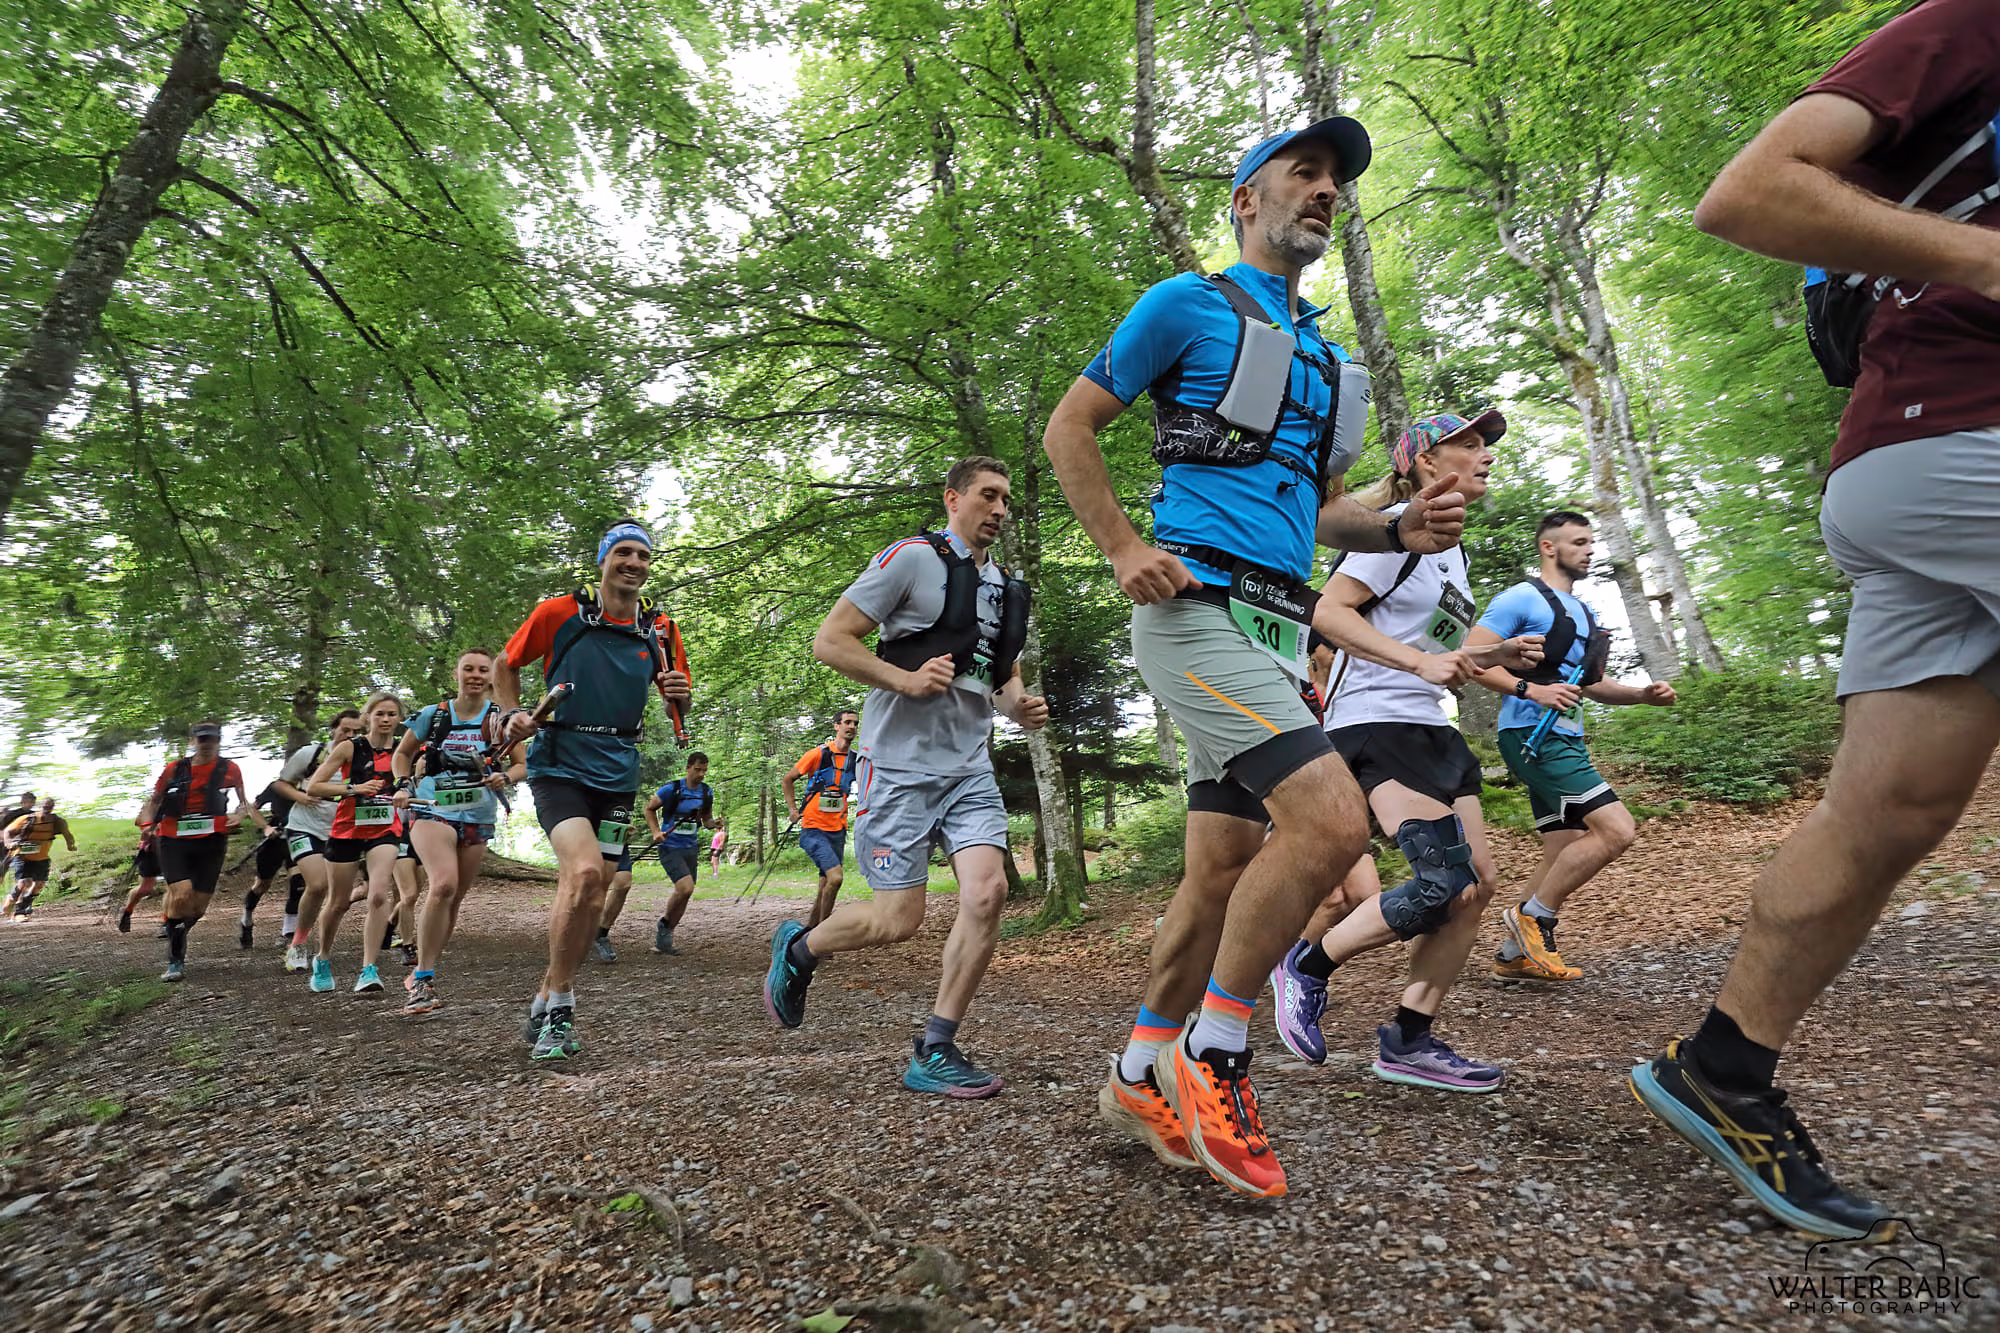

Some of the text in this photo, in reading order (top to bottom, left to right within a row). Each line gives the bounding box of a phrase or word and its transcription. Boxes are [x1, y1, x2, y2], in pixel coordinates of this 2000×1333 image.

[1253, 615, 1280, 651] 30
[1433, 619, 1457, 642] 67
[1284, 977, 1295, 1009] HOKA
